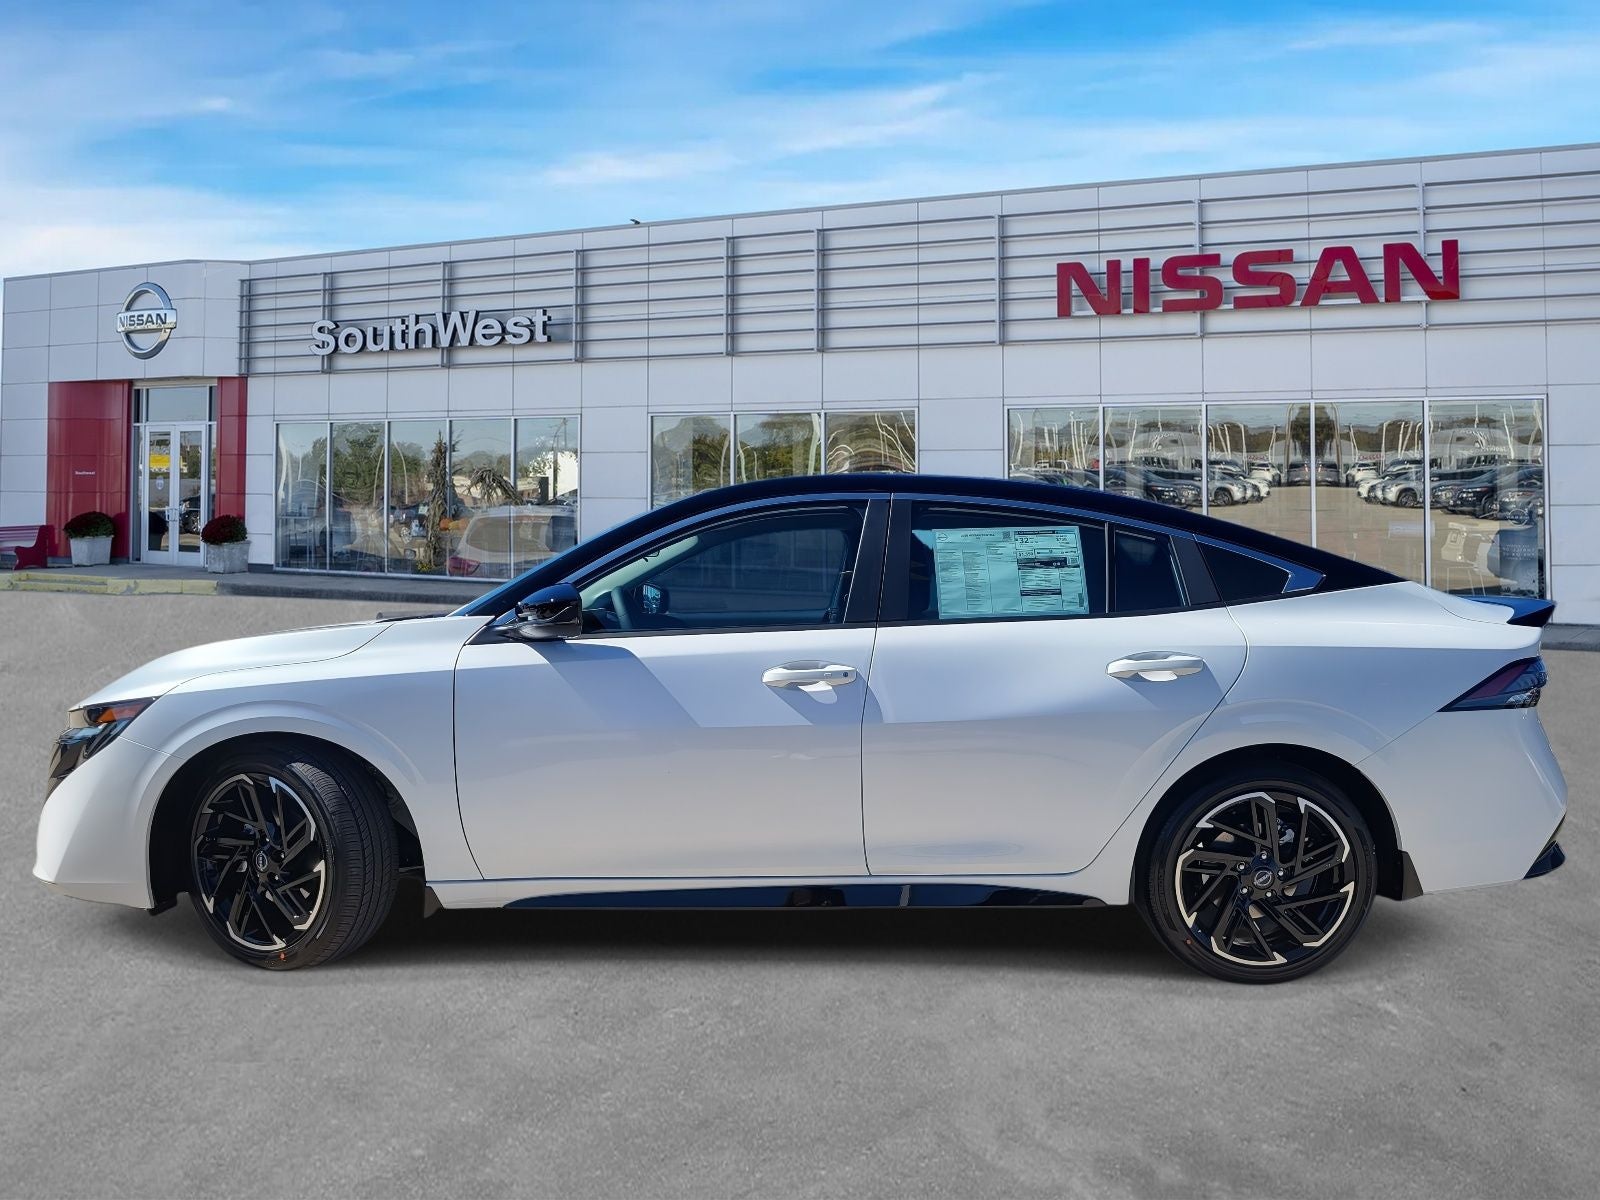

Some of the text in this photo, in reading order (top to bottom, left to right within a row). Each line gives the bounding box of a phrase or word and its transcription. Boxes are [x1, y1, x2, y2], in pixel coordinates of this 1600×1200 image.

[1056, 239, 1460, 318] NISSAN
[119, 312, 167, 328] NISSAN
[309, 308, 552, 356] SouthWest
